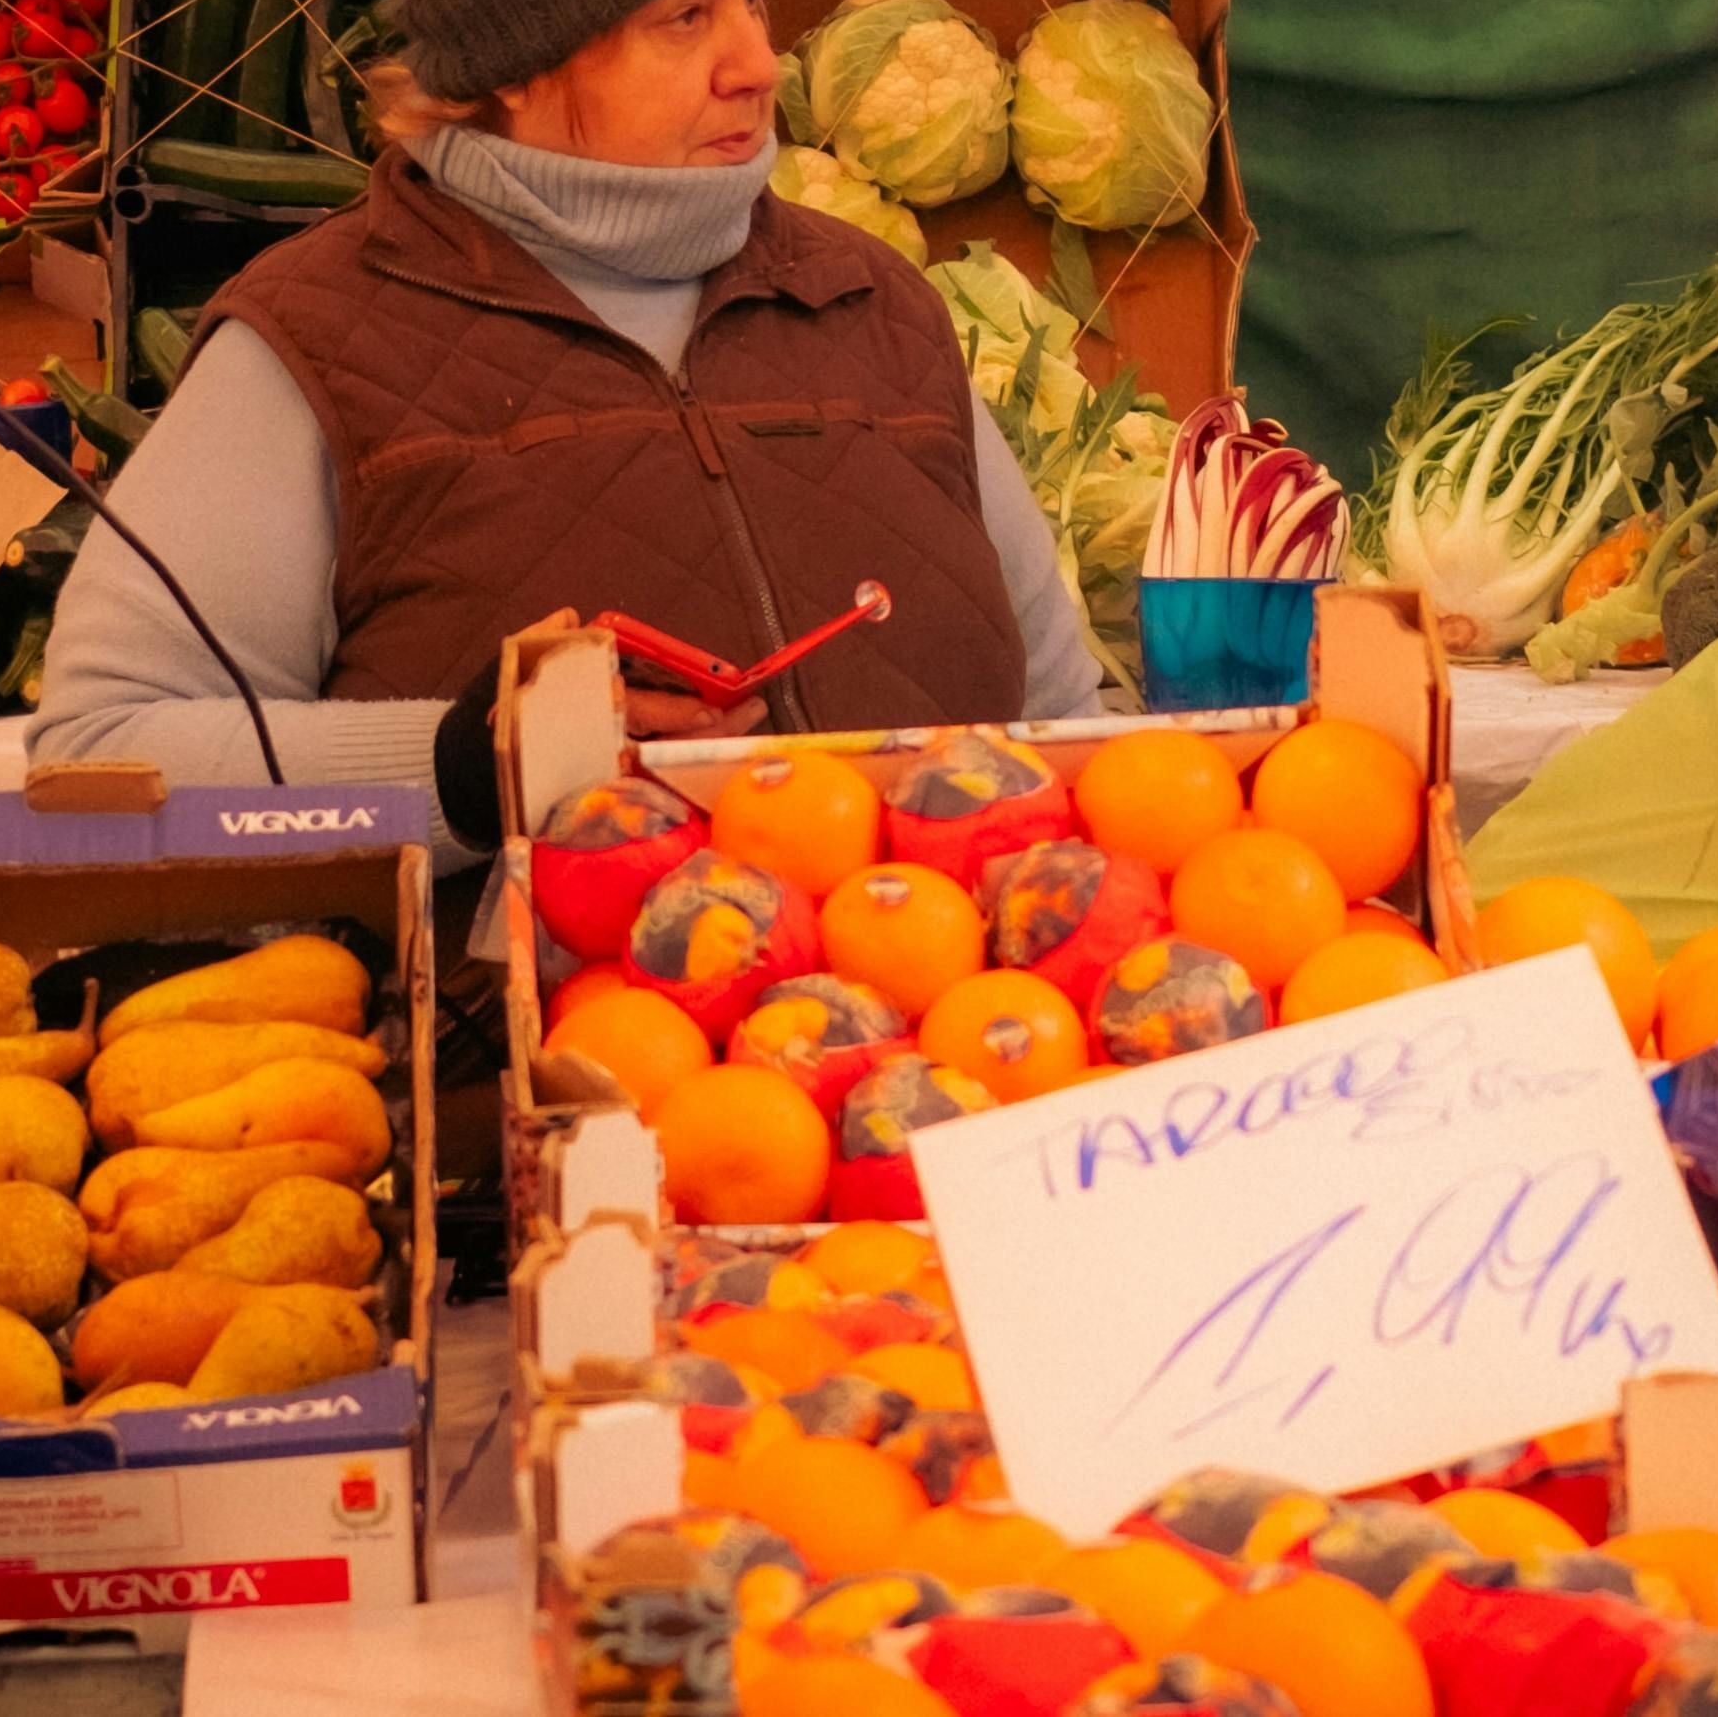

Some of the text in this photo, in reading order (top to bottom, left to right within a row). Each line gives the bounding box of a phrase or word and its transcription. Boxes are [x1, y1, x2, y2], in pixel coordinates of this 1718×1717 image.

[218, 806, 374, 836] VIGNOLA
[185, 1393, 364, 1432] VIGNOLA
[51, 1570, 264, 1614] VIGNOLA
